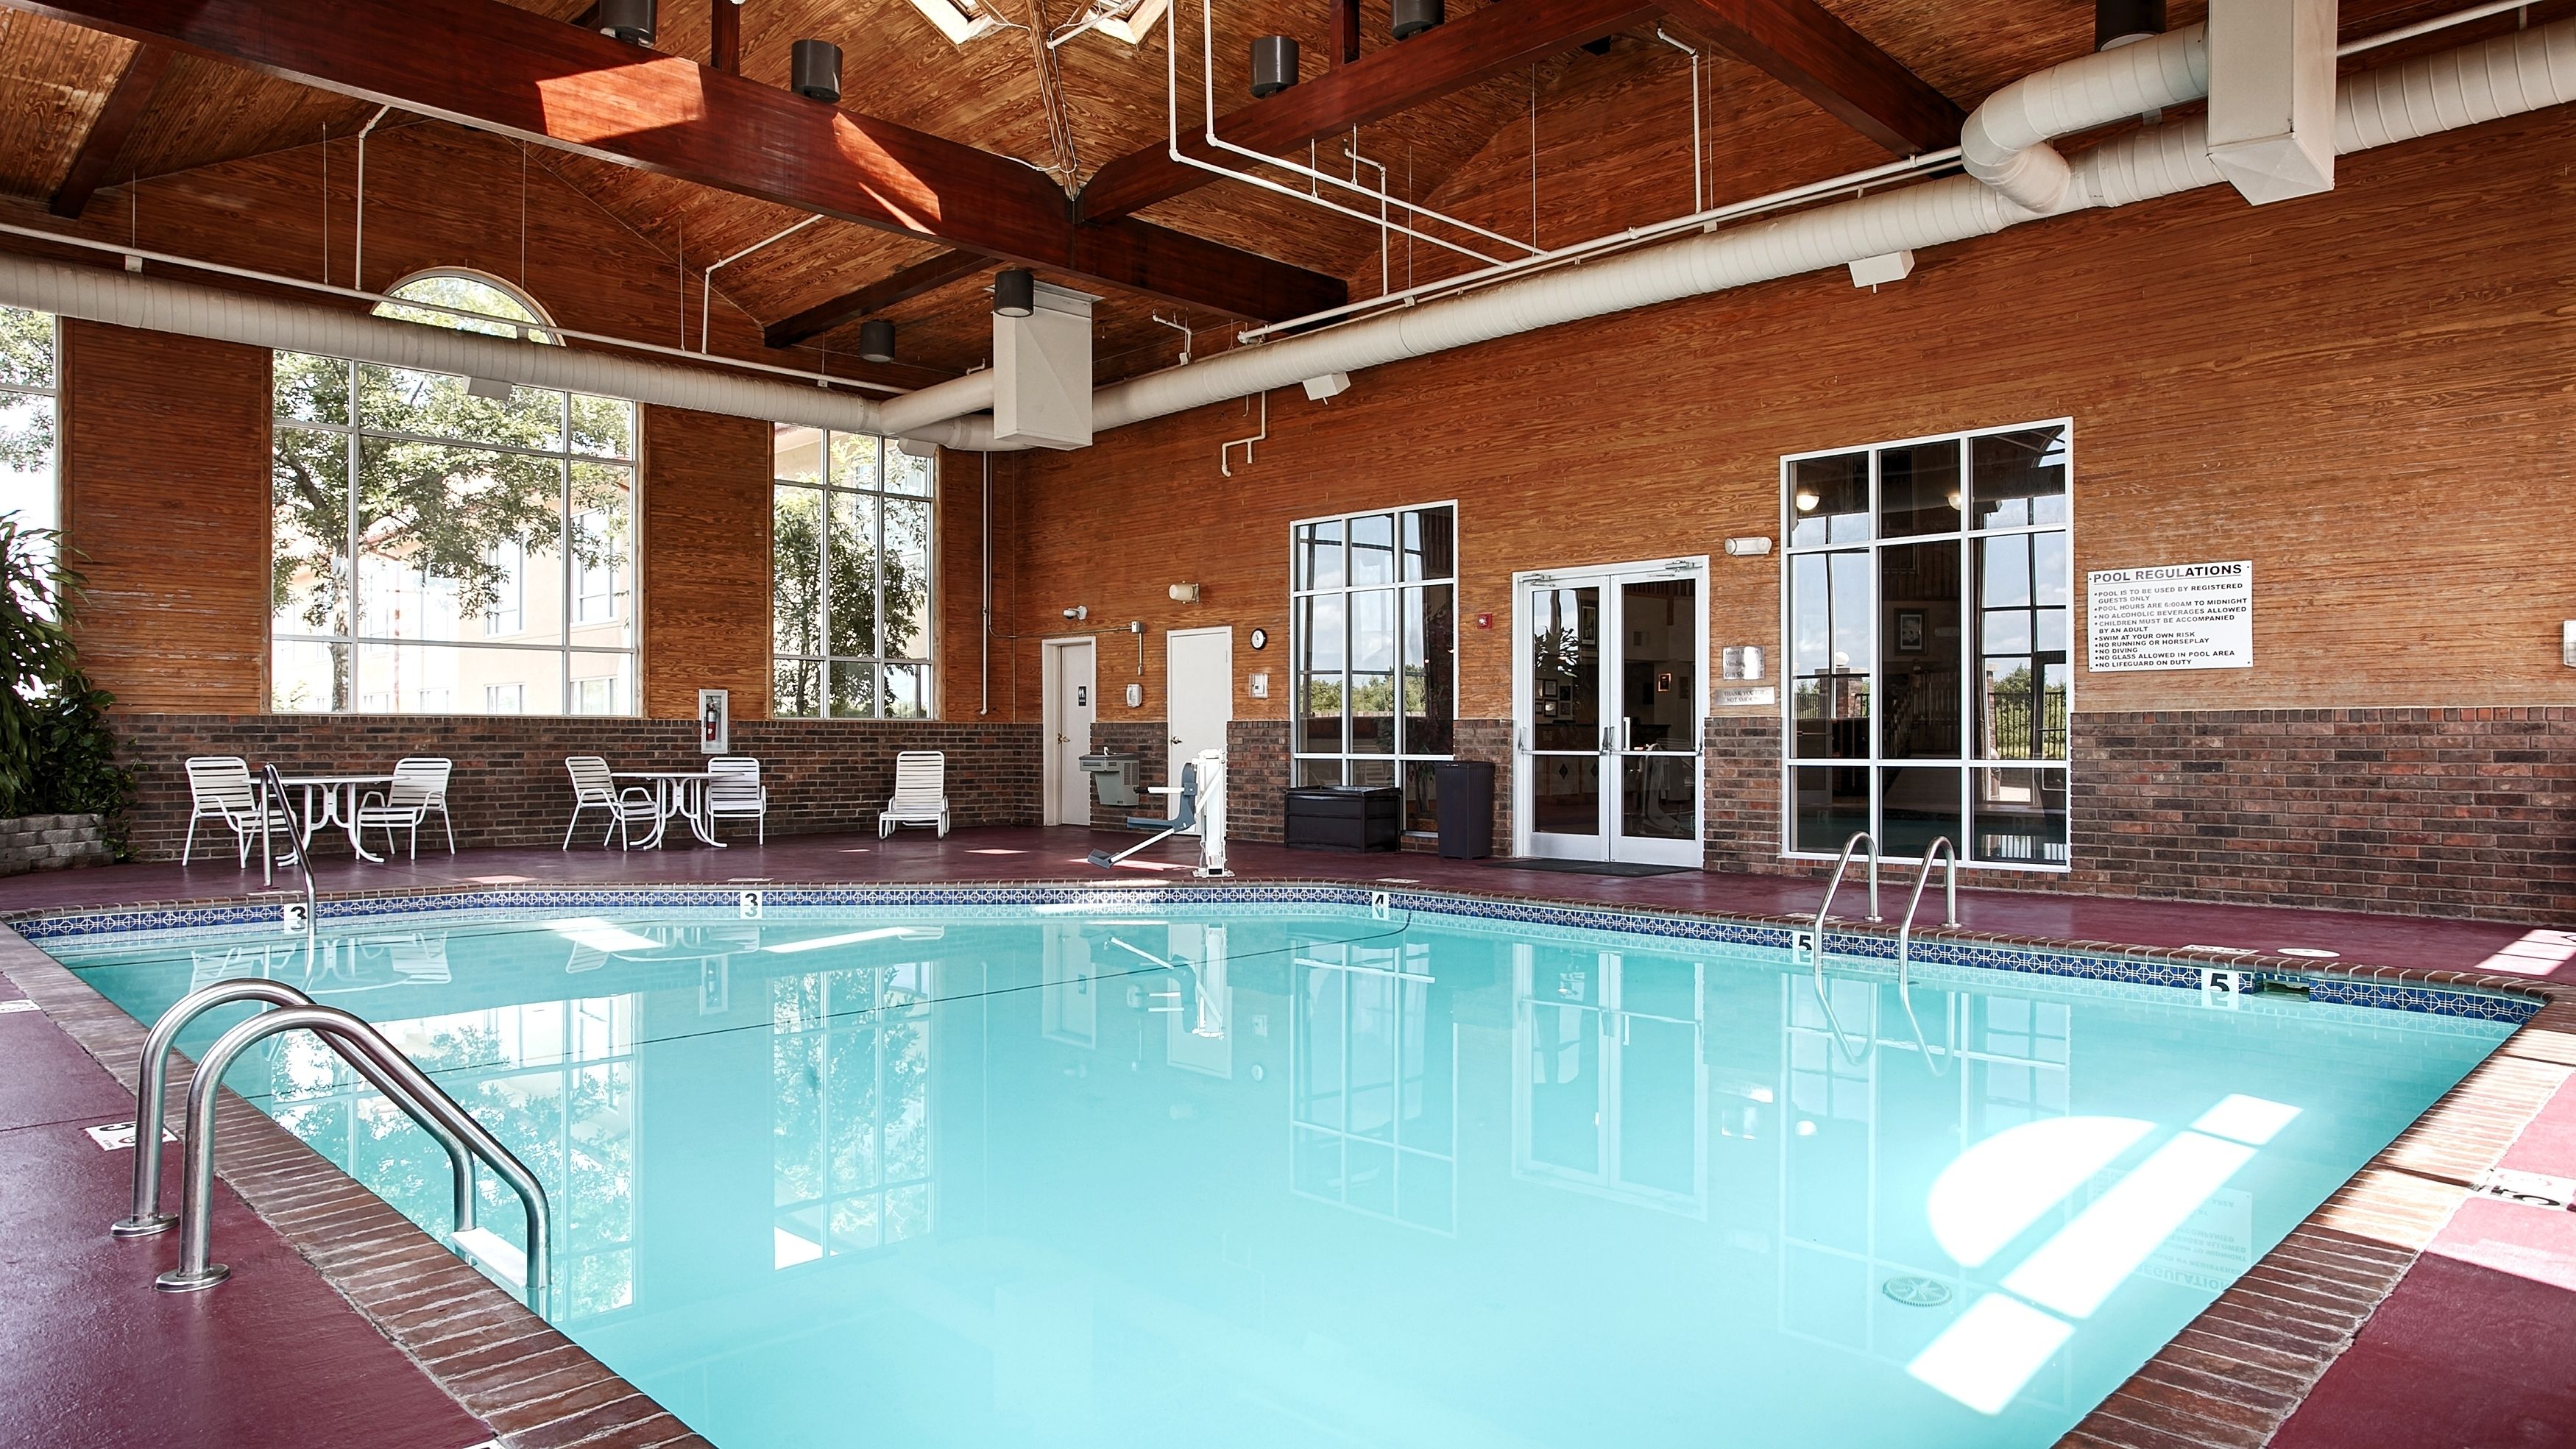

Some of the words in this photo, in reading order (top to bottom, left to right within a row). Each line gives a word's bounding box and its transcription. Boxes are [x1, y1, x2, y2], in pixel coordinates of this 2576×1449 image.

[2094, 572, 2131, 583] POOL
[2135, 564, 2242, 580] REGULATIONS
[2191, 583, 2243, 591] REGISTERED
[745, 893, 758, 907] 3
[1798, 935, 1813, 951] 5
[2210, 973, 2230, 992] 5
